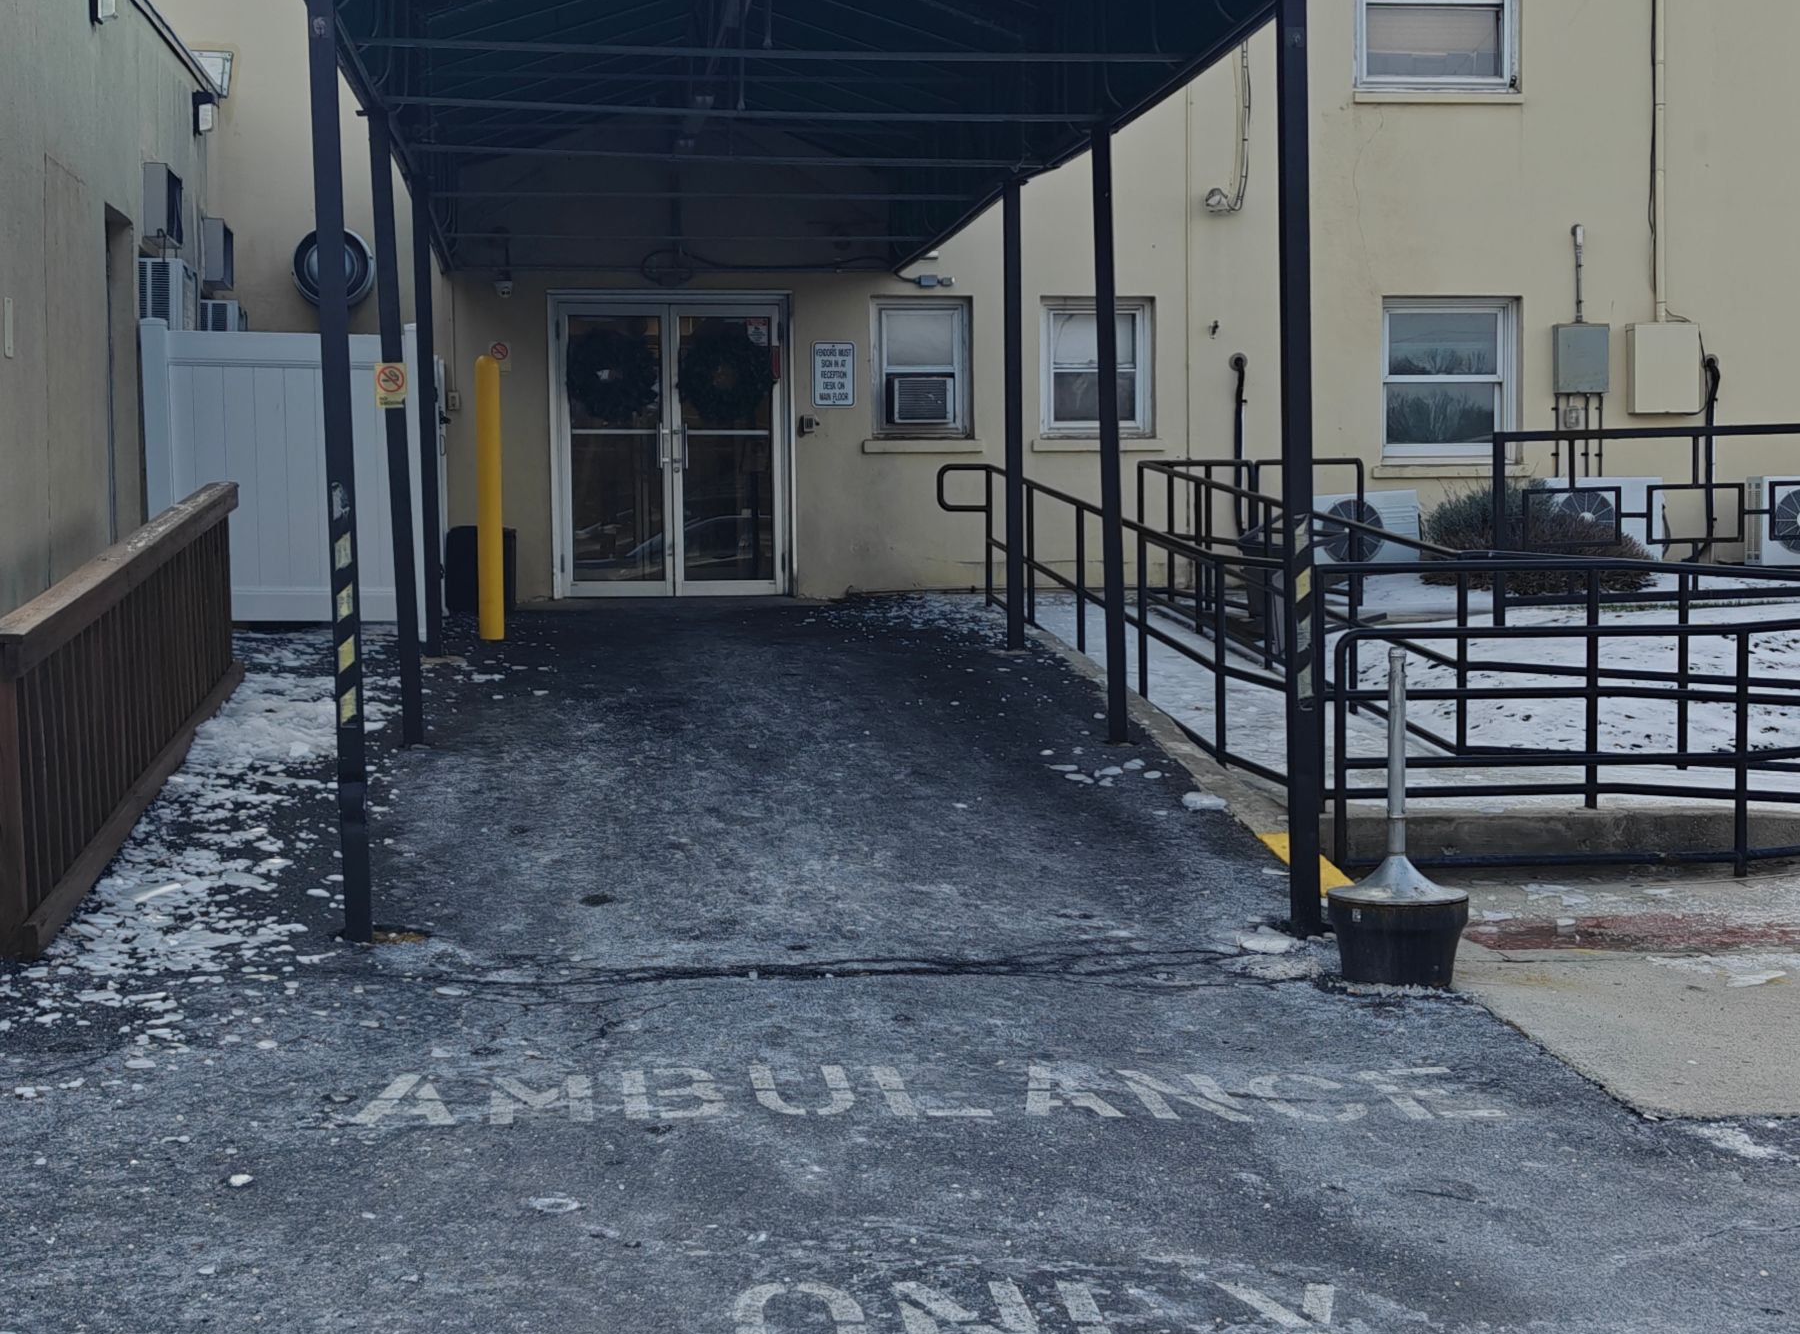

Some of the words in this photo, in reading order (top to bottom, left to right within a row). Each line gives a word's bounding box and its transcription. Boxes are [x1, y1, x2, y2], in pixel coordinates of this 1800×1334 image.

[821, 359, 833, 368] SIGN
[834, 359, 839, 368] IN
[840, 359, 847, 368] AT
[820, 370, 847, 379] RECEPTION
[823, 381, 836, 390] DESK
[837, 381, 845, 390] ON
[832, 392, 849, 401] FLOOR
[352, 1064, 1510, 1126] AMBULANCE
